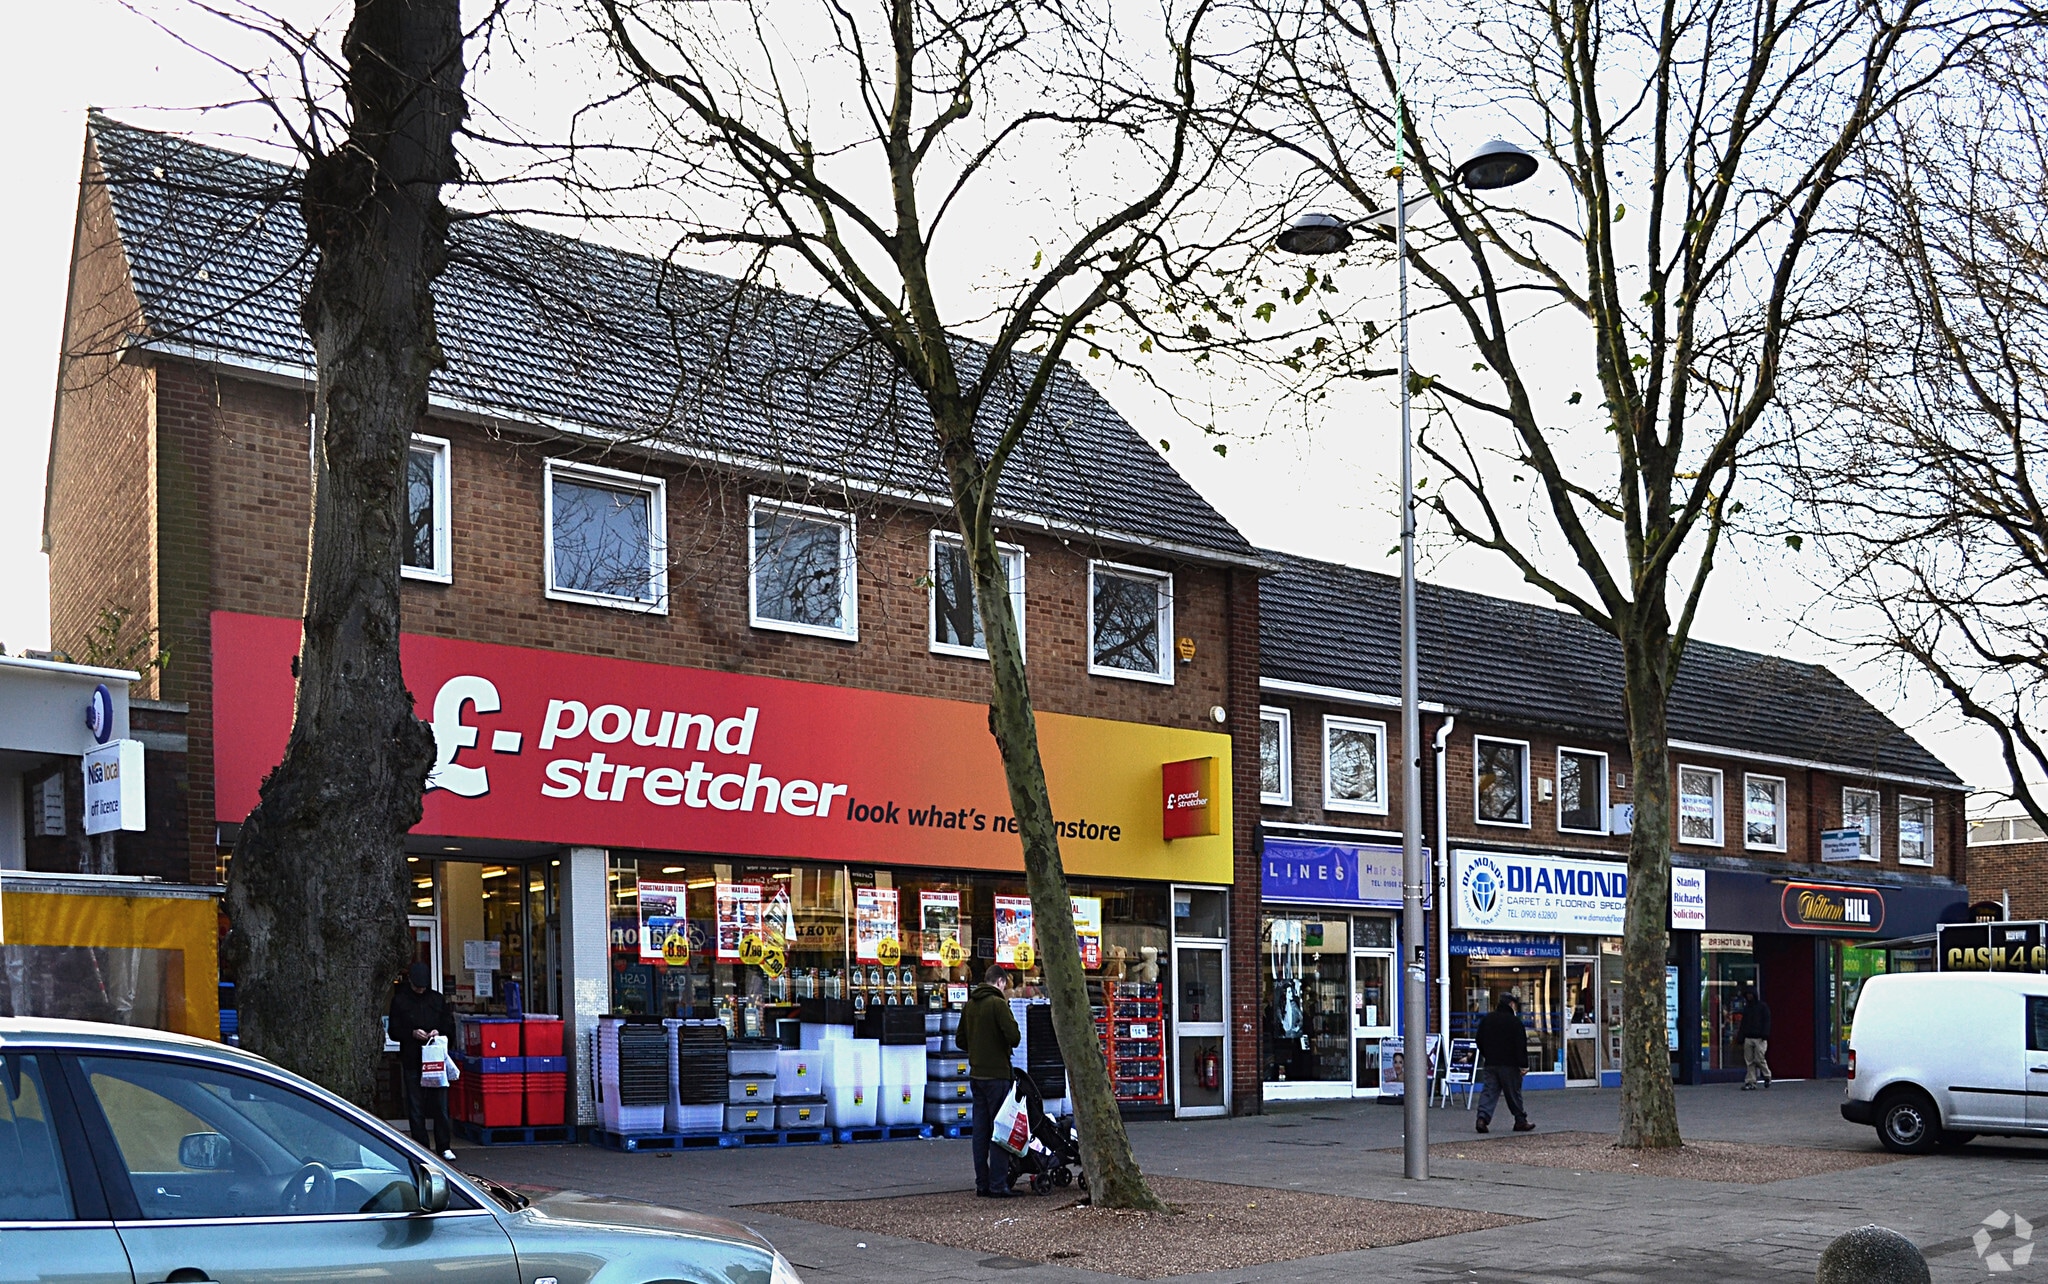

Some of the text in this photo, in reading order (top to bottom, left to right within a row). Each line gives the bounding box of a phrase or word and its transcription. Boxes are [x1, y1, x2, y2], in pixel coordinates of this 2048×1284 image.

[539, 698, 759, 755] pound
[88, 757, 120, 785] Nisa local
[541, 752, 848, 818] stretcher
[1177, 790, 1199, 801] pound
[1177, 797, 1209, 809] stretcher
[91, 799, 119, 817] off licence
[847, 798, 1121, 841] look what's ne nstore
[1269, 862, 1345, 881] LINES
[1366, 864, 1403, 876] Hair Sa
[1507, 865, 1627, 898] DIAMOND
[1677, 876, 1700, 889] Stanley
[1507, 896, 1540, 906] CARPET
[1555, 899, 1595, 909] FLOORING
[1600, 901, 1627, 910] SPECIA
[1674, 892, 1703, 904] Richards
[1673, 908, 1705, 920] Solicitors
[1798, 891, 1871, 922] William HILL
[1521, 910, 1537, 919] 01908
[1538, 911, 1558, 919] 632800
[1574, 914, 1625, 923] www.diamondsfloor
[1514, 947, 1528, 955] FREE
[1529, 947, 1561, 956] ESTIMATES
[1948, 946, 2006, 970] CASH
[2009, 946, 2028, 971] 4
